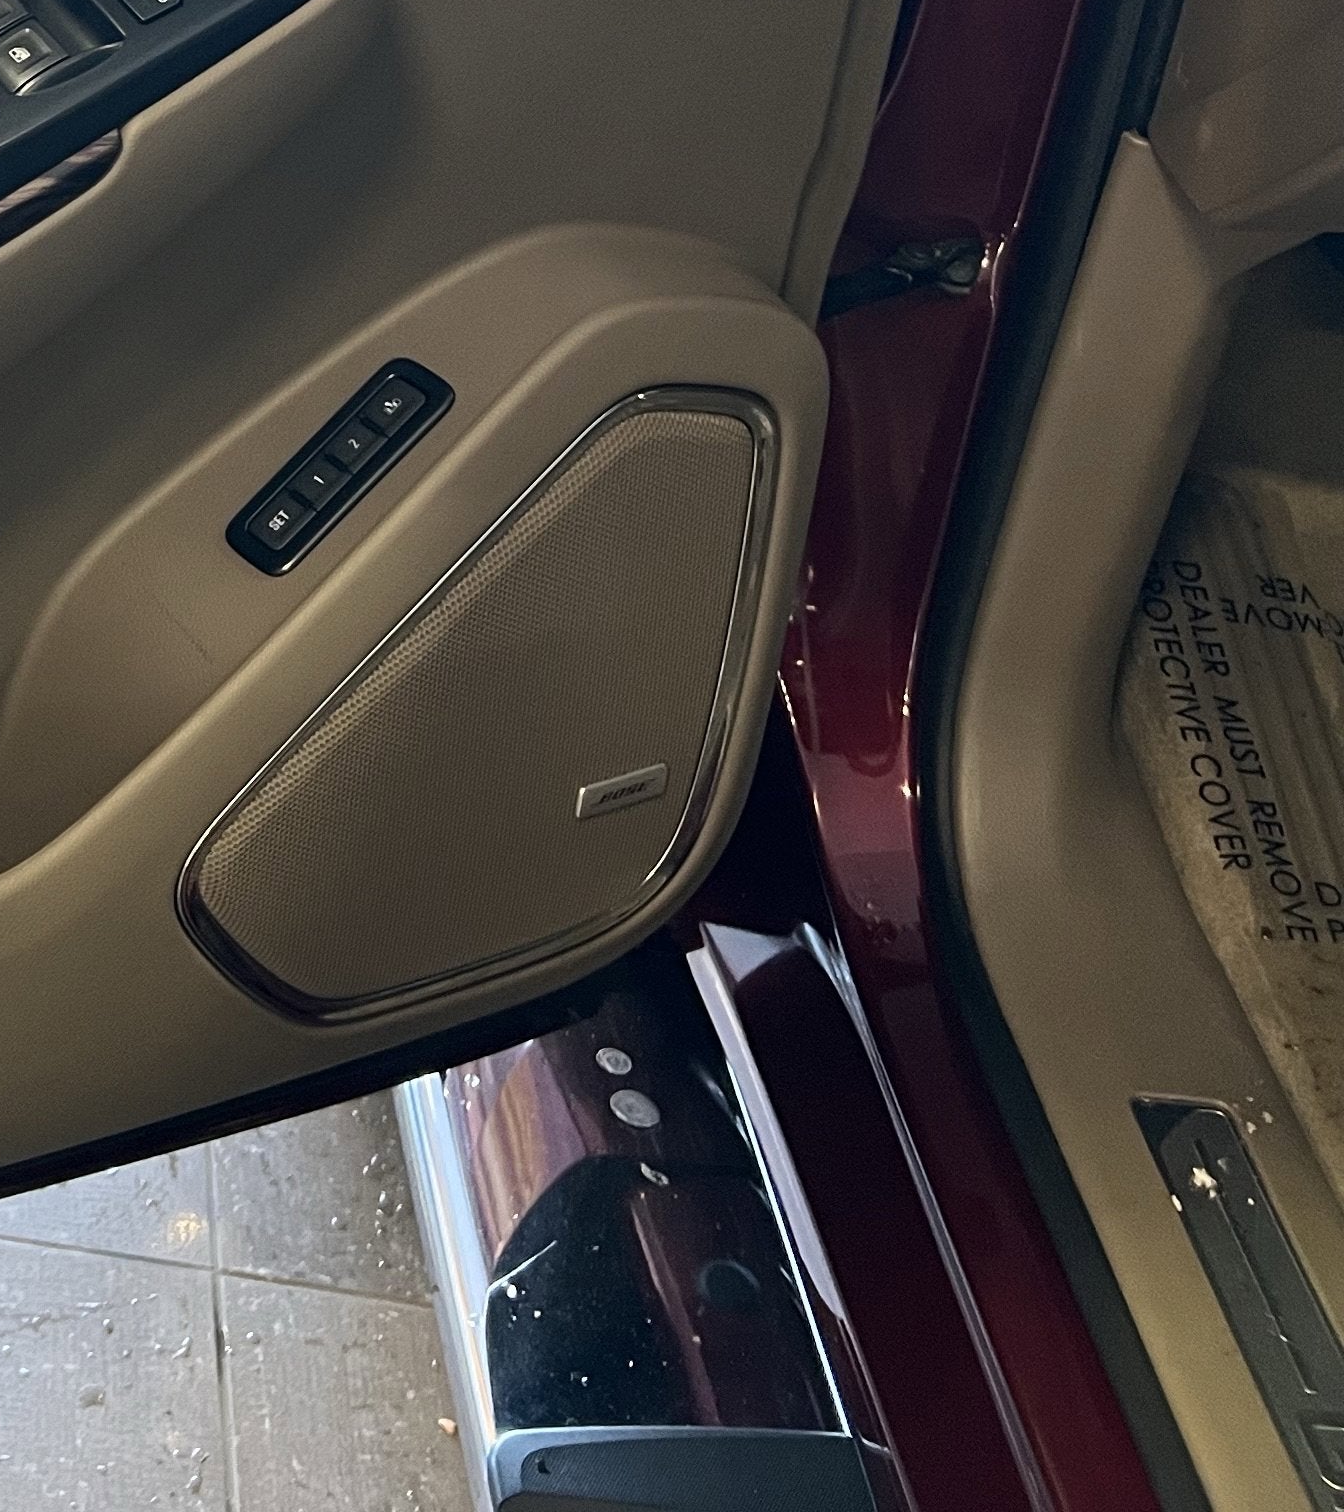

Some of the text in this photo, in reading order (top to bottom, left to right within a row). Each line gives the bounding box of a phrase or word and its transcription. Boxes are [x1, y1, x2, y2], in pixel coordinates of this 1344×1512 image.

[348, 439, 360, 449] 2
[268, 510, 289, 531] SET
[1172, 559, 1319, 944] DEALER MUST REMOVE
[1190, 753, 1253, 872] COVER
